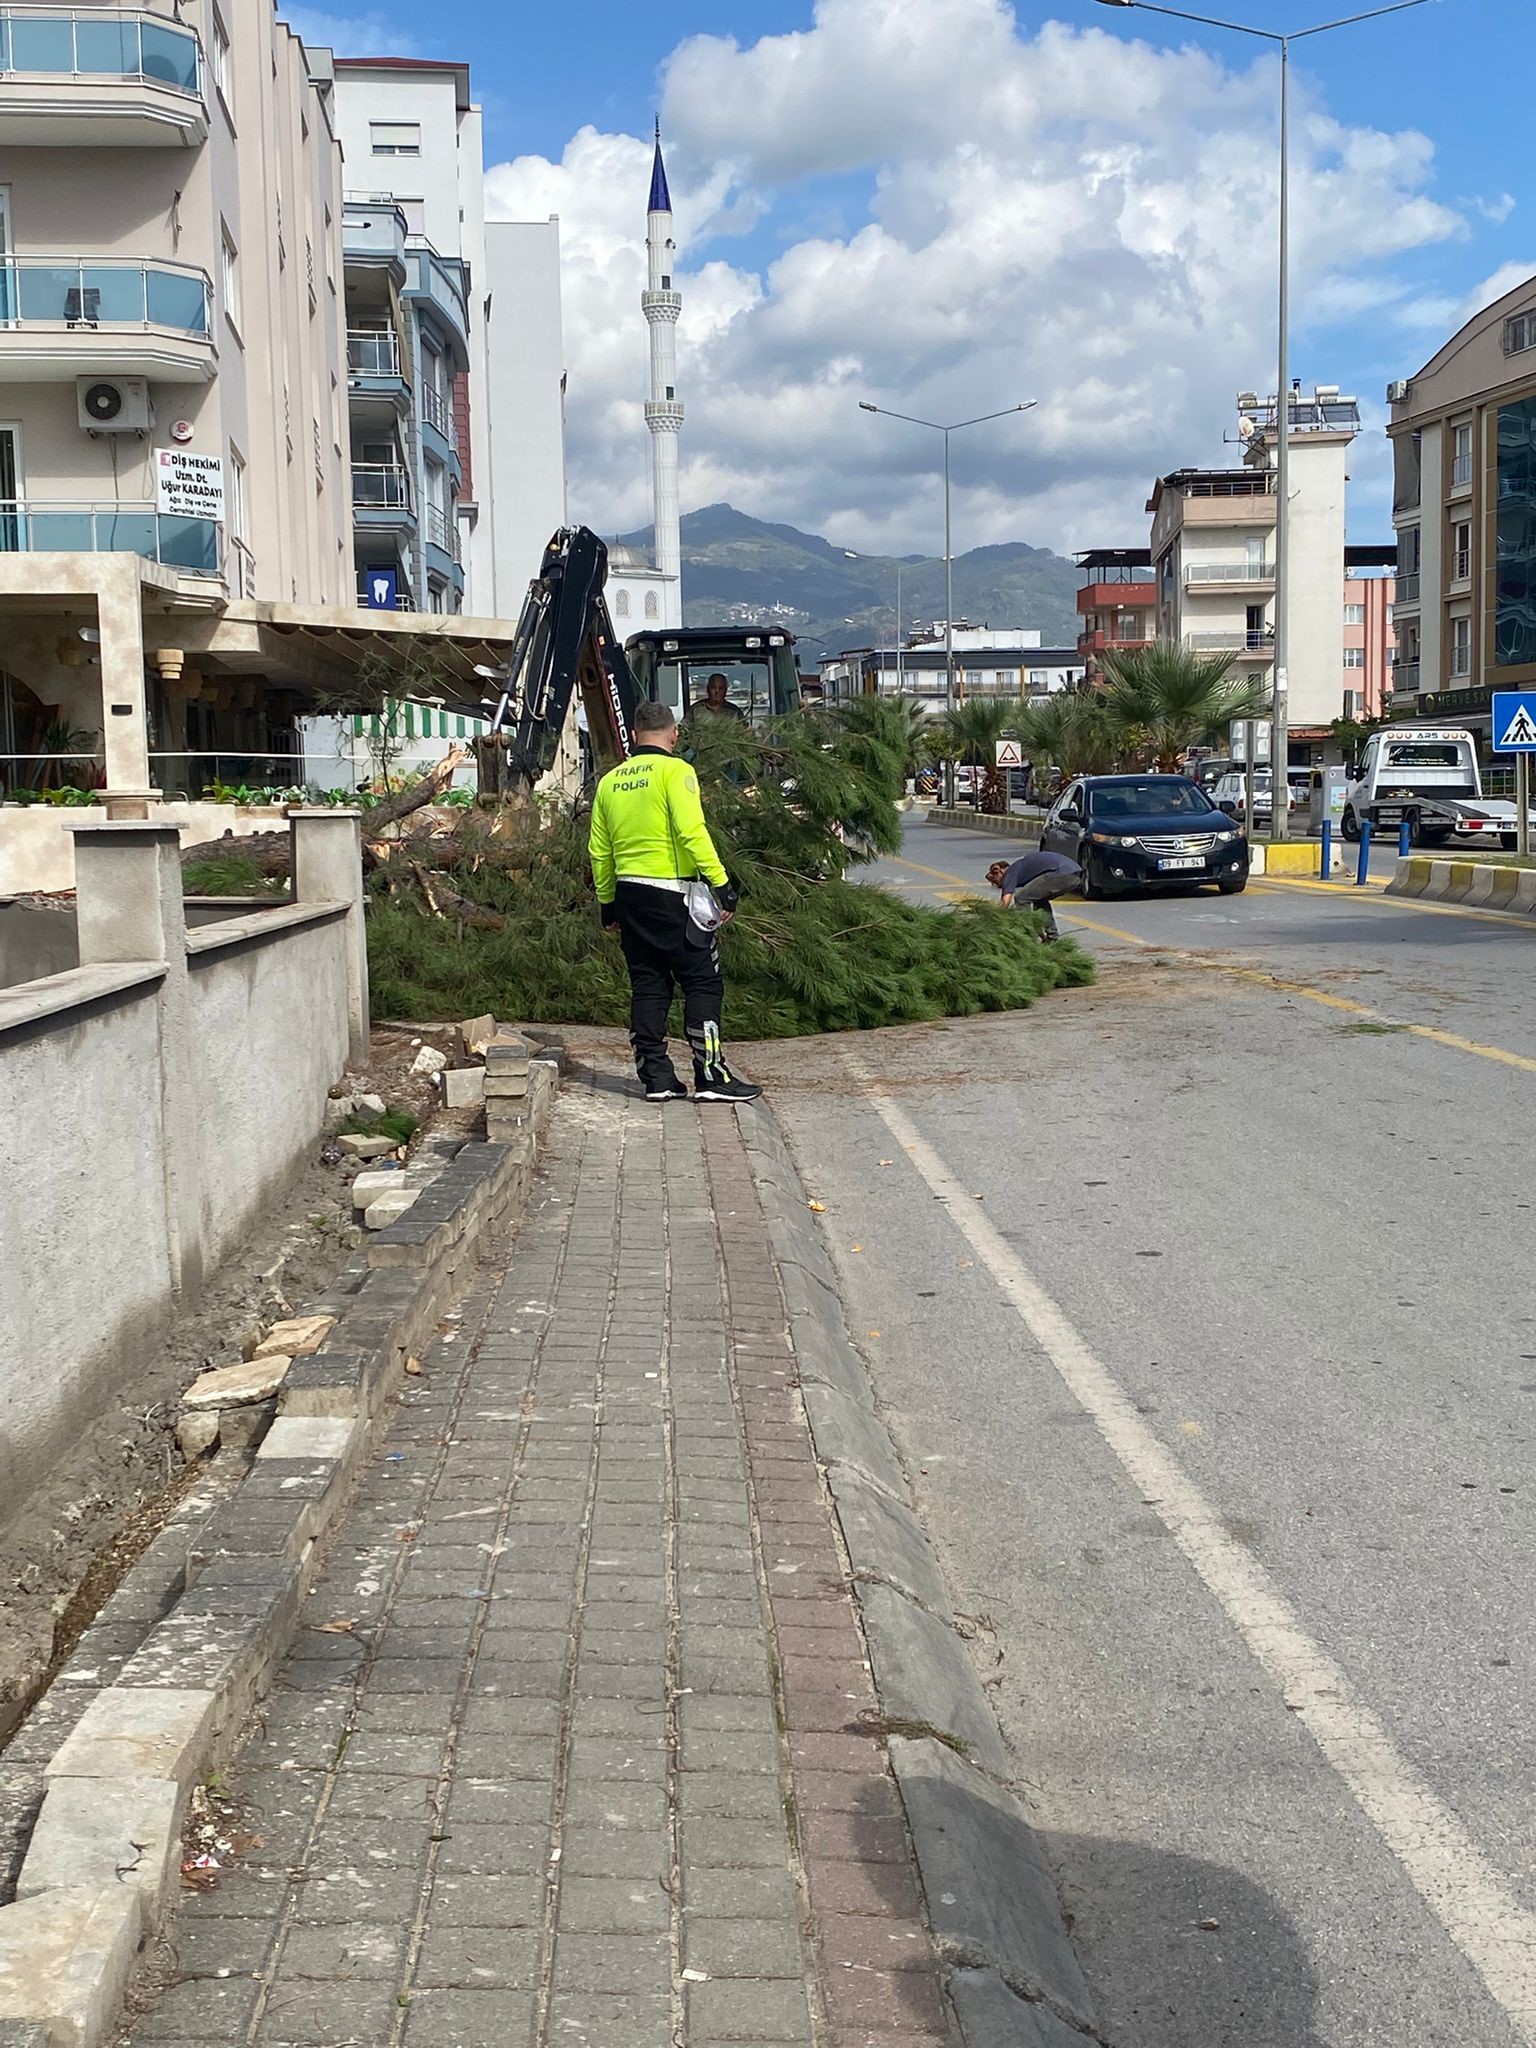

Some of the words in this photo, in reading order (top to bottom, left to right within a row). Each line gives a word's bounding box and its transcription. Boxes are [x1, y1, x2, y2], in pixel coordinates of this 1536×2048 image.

[171, 453, 187, 468] DİŞ
[188, 458, 221, 471] HEKİMİ
[161, 480, 181, 494] Uğur
[182, 483, 222, 498] KARADAYI
[1437, 692, 1471, 707] MERVE
